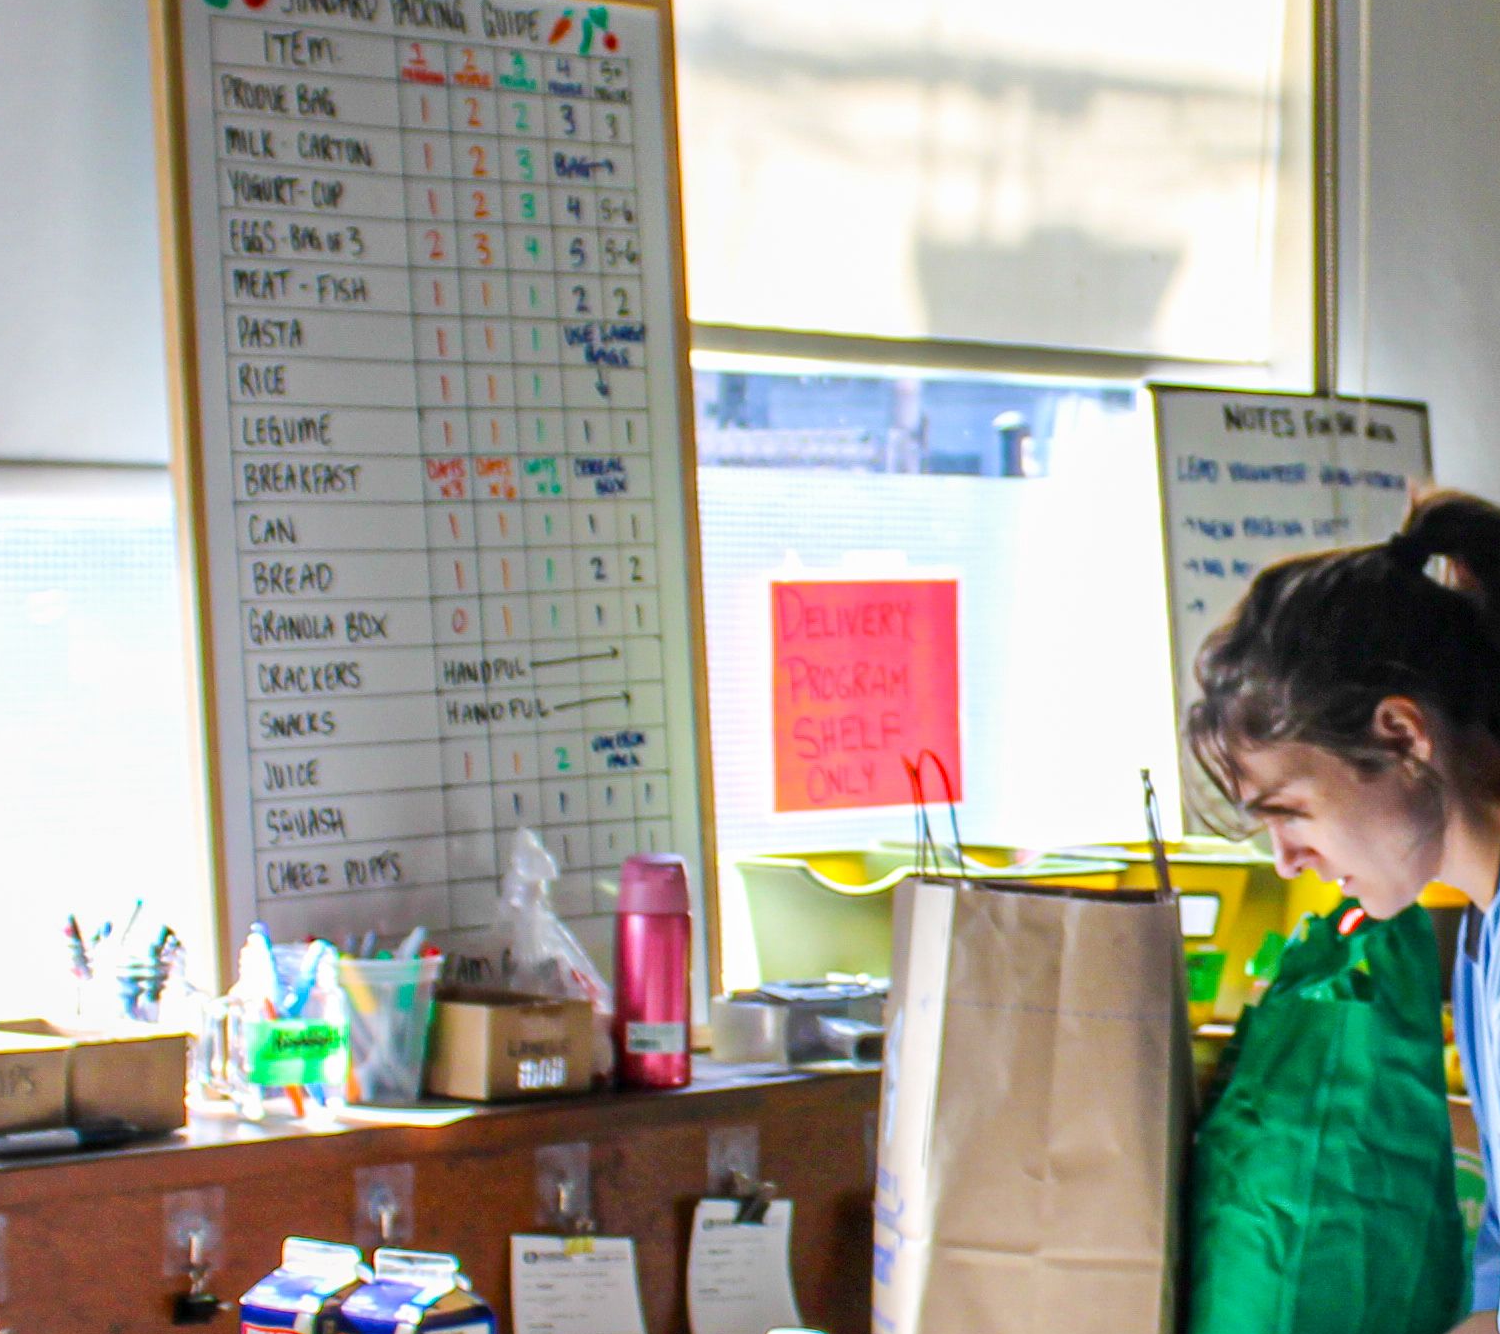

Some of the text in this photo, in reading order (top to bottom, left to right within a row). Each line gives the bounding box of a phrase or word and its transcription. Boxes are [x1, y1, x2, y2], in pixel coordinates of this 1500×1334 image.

[264, 29, 334, 66] ITEM
[296, 83, 338, 118] BAG
[464, 97, 483, 128] 2
[512, 101, 530, 131] 2
[560, 104, 577, 136] 3
[225, 126, 276, 159] MILK
[298, 130, 373, 168] CARTON
[469, 145, 488, 177] 2
[516, 147, 535, 181] 3
[311, 178, 345, 209] CUP
[472, 190, 490, 220] 2
[520, 192, 536, 220] 3
[566, 194, 581, 221] 4
[346, 225, 365, 257] 3
[424, 229, 445, 260] 2
[472, 231, 493, 266] 3
[524, 235, 541, 263] 4
[569, 237, 586, 267] 5
[233, 268, 292, 300] MEAT
[316, 273, 367, 303] FISH
[572, 284, 591, 314] 2
[613, 287, 631, 316] 2
[237, 315, 303, 349] PASTA
[436, 327, 447, 358] 1
[238, 365, 286, 398] RICE
[241, 413, 332, 447] LEGUME
[1222, 402, 1297, 438] NOTES
[243, 463, 362, 499] BREAKFAST
[248, 514, 297, 545] CAN
[252, 560, 333, 597] BREAD
[454, 559, 465, 591] 1
[590, 556, 607, 580] 2
[629, 555, 644, 582] 2
[247, 604, 334, 646] GRANOLA
[345, 607, 389, 639] BOX
[502, 603, 513, 636] 1
[781, 587, 916, 642] DELIVERY
[258, 656, 527, 699] CRACKERS HANDFUL
[789, 658, 908, 701] PROGRAM
[259, 697, 550, 740] SNACKS HANDFUL
[792, 714, 902, 760] SHELF
[262, 759, 320, 791] JUICE
[555, 746, 571, 772] 2
[806, 764, 885, 806] ONLY
[266, 808, 346, 845] SQUASH
[265, 850, 402, 894] CHEEZ PUFFS
